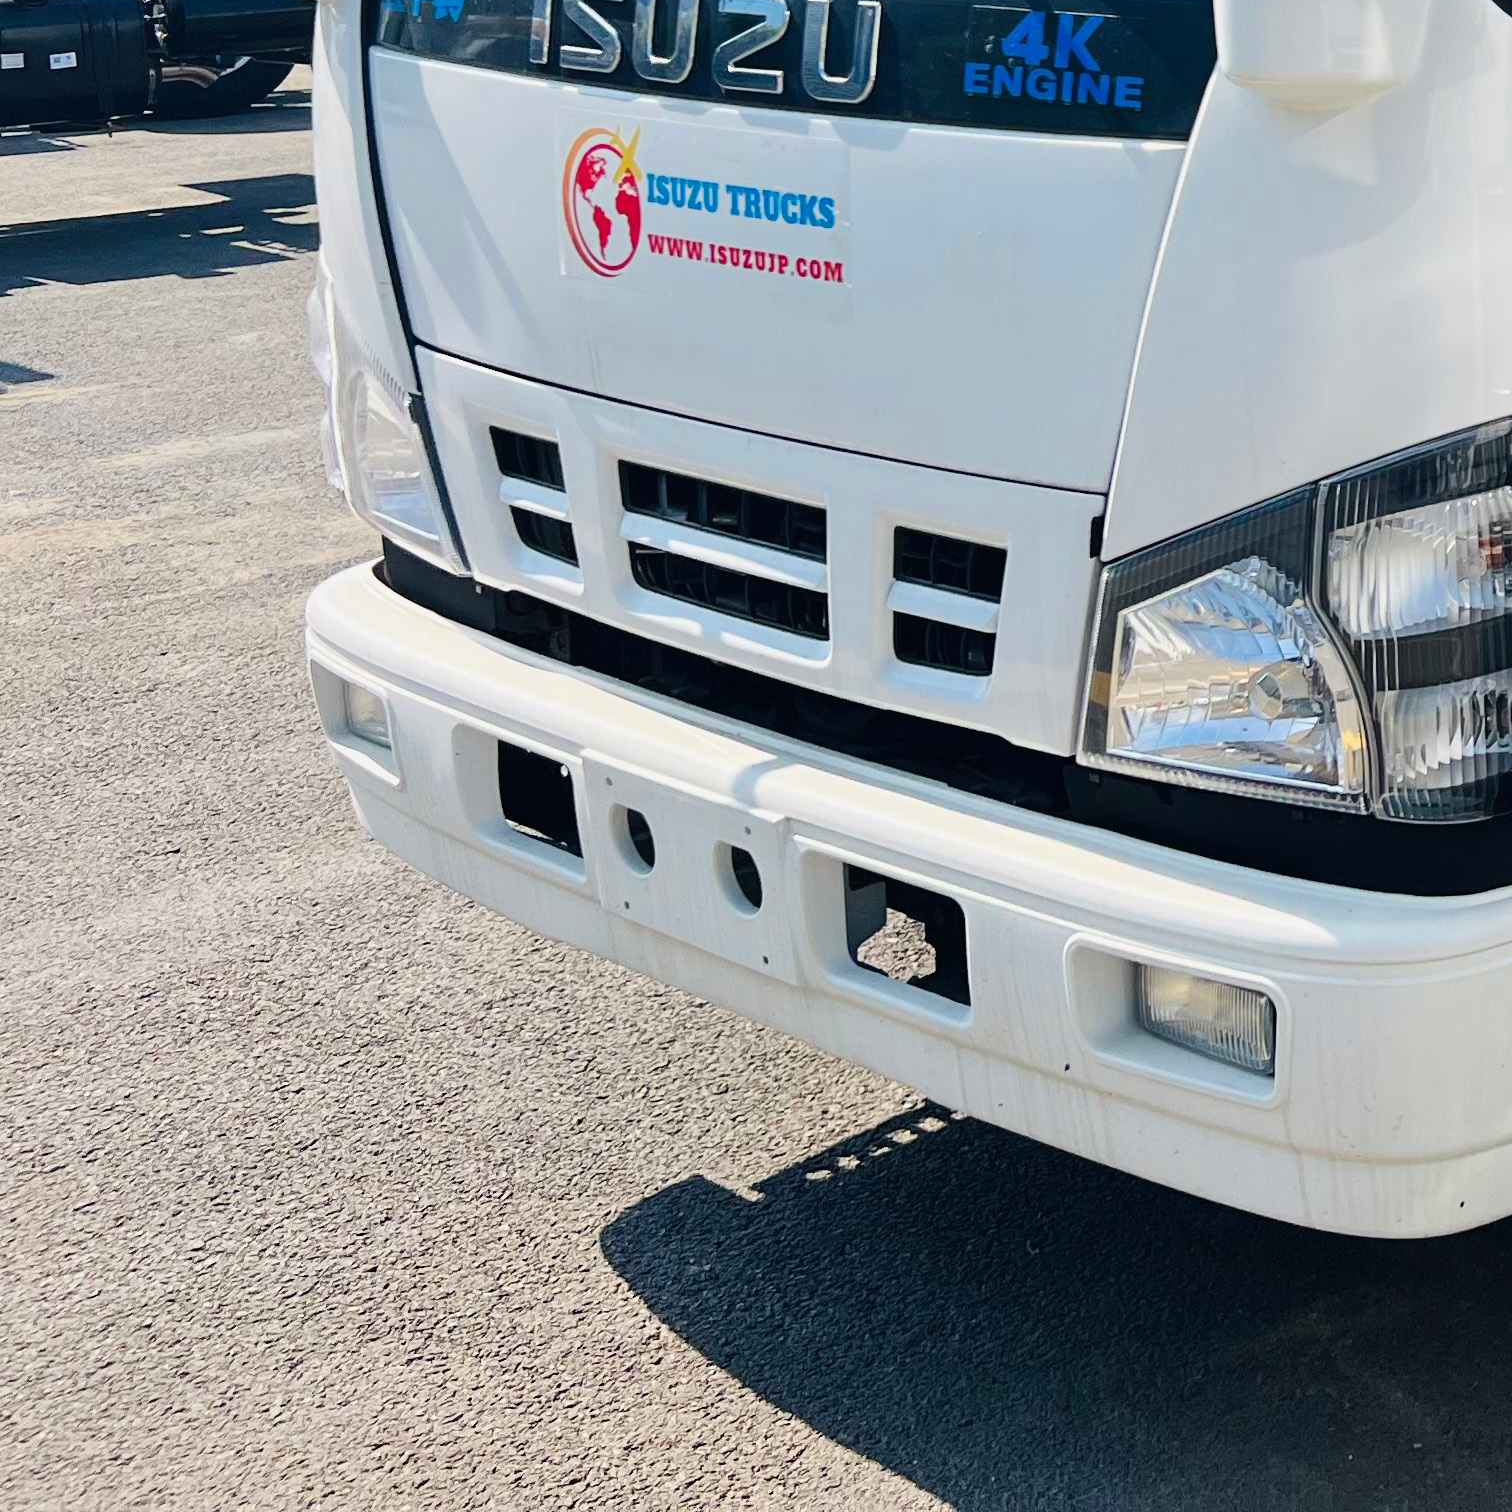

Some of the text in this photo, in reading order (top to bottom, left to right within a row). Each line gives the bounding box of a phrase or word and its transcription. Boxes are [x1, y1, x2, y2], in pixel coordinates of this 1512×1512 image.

[1001, 10, 1105, 72] 4K
[963, 61, 1145, 110] ENGINE
[647, 173, 836, 229] ISUZU TRUCKS
[647, 234, 845, 284] WWW.ISUZUJP.COM
